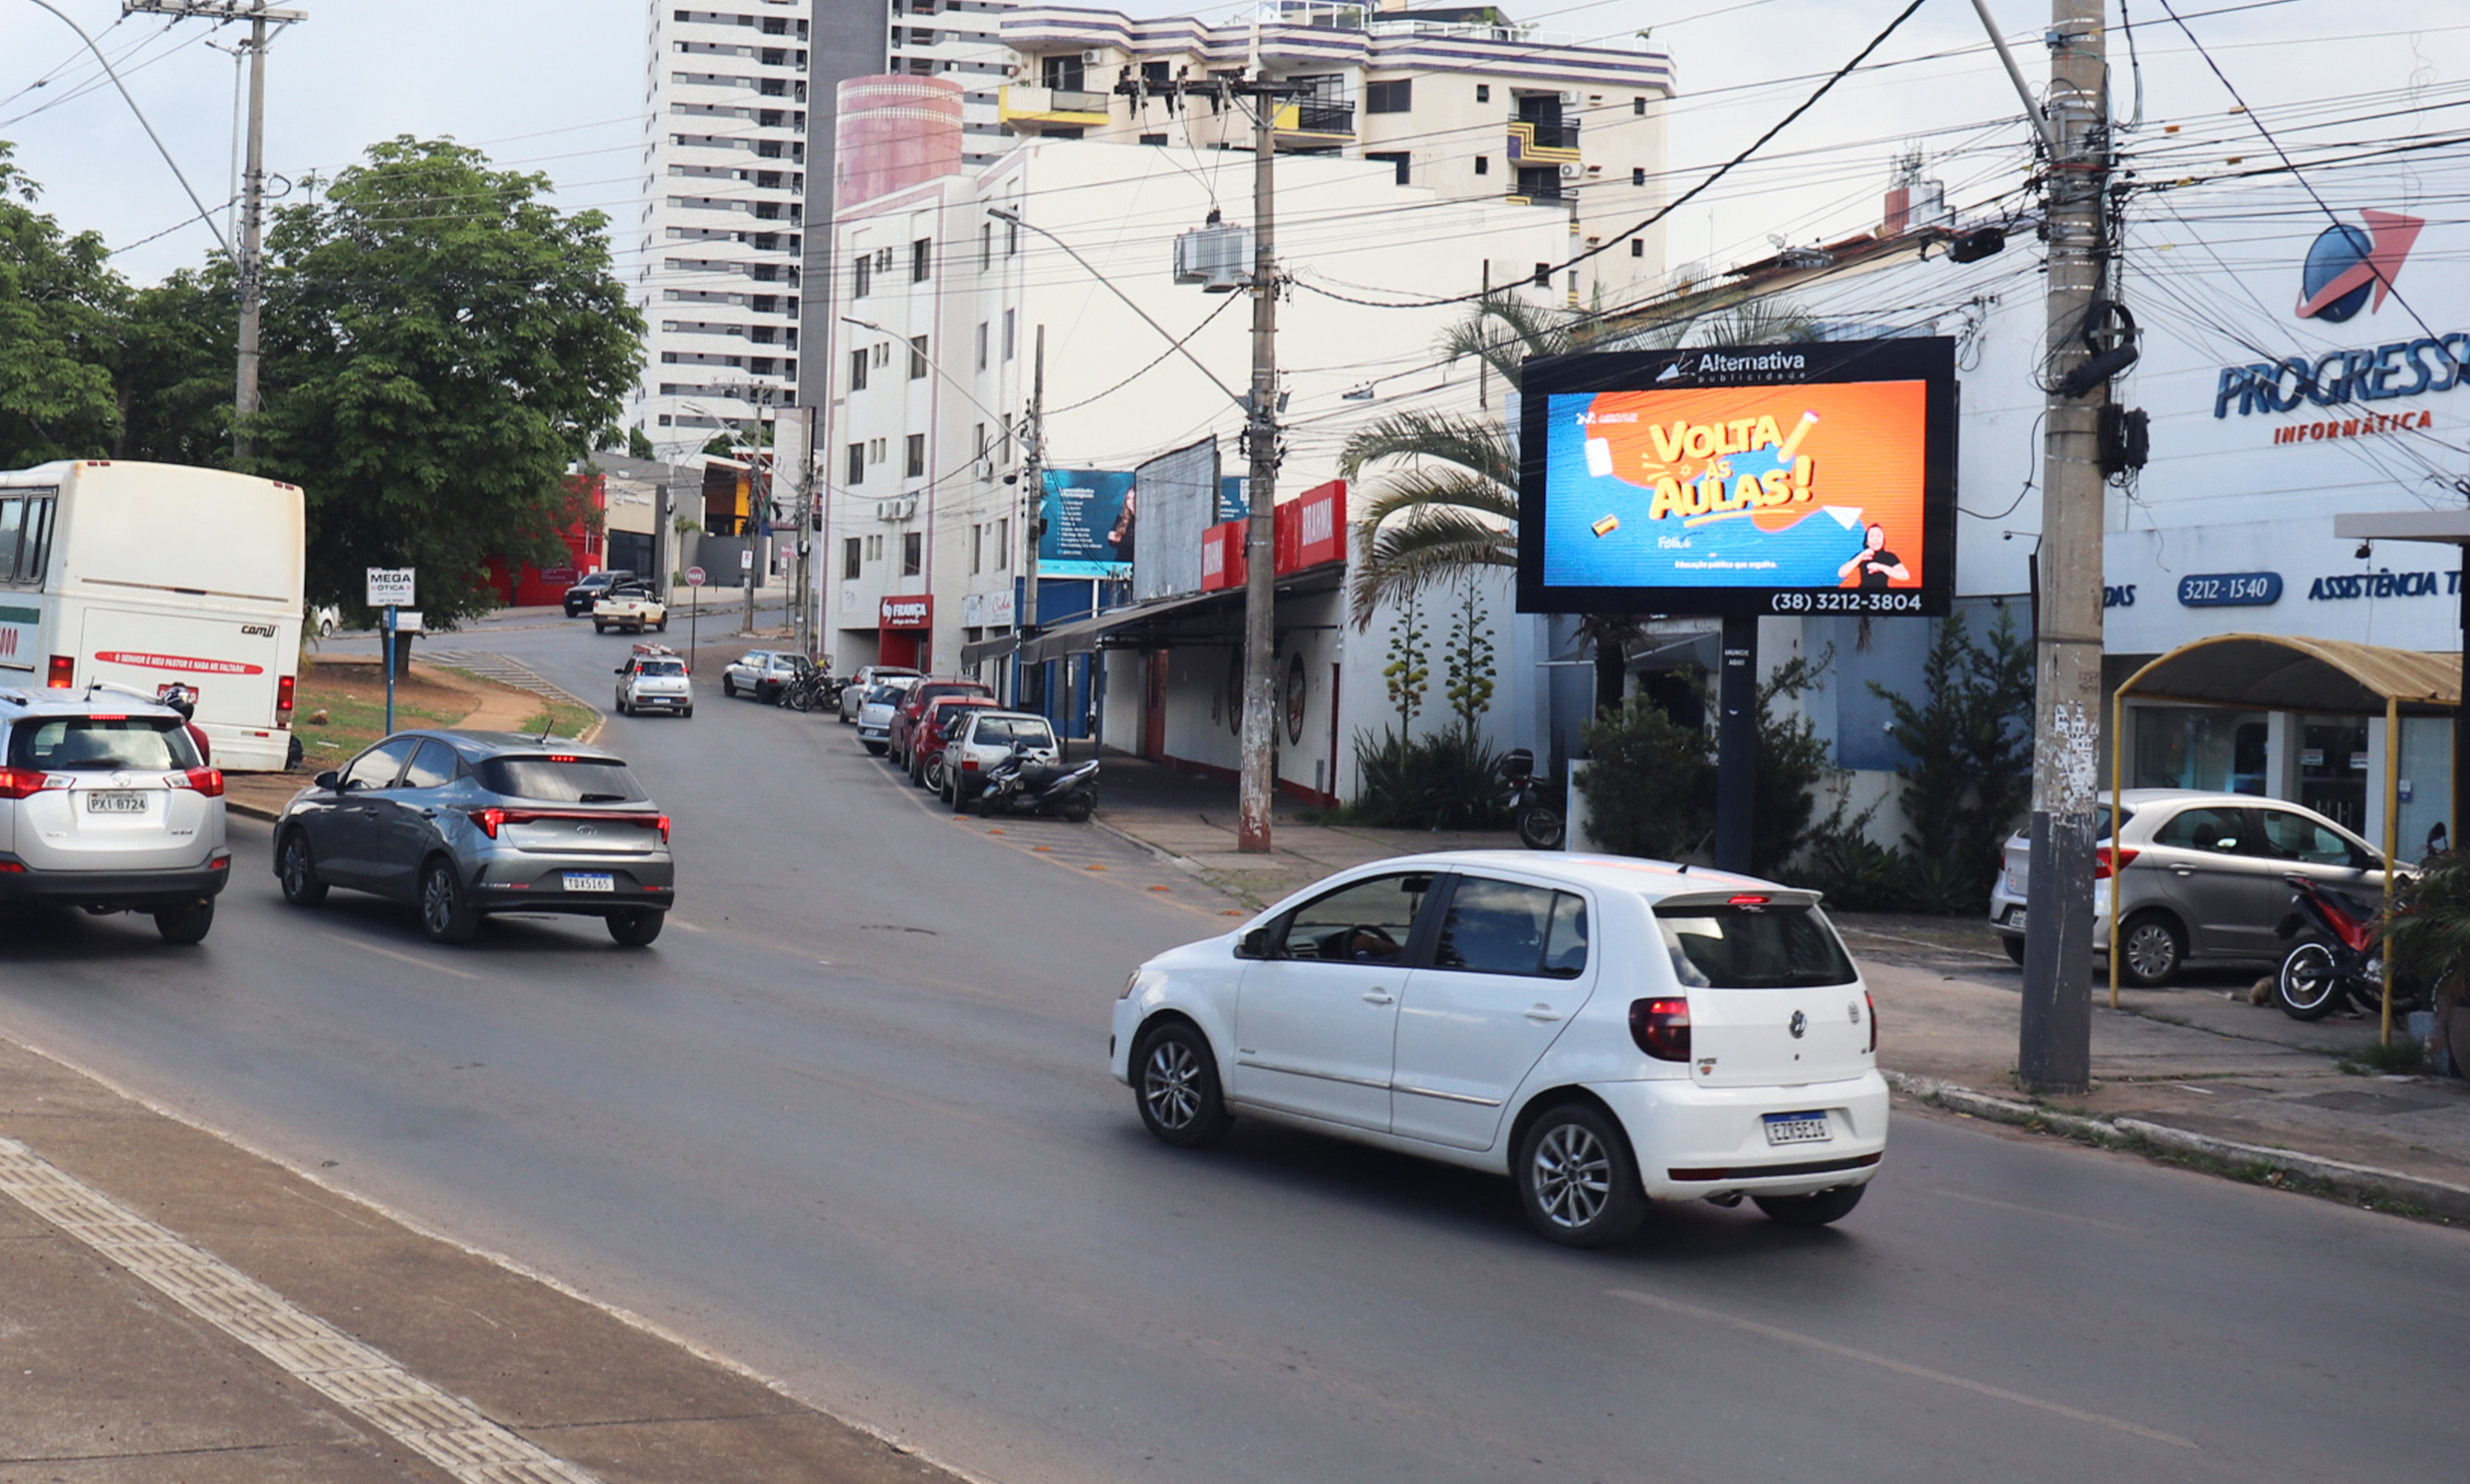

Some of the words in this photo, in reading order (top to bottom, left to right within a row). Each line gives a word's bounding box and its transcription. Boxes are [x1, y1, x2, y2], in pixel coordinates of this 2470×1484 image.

[1698, 351, 1806, 372] Alternativa
[1697, 371, 1807, 383] publicidade
[2273, 409, 2432, 445] INFORMÁTICA
[1648, 414, 1786, 463] VOLTA
[1705, 457, 1734, 480] ÀS
[1648, 454, 1815, 520] AULAS!
[370, 574, 411, 584] MEGA
[2307, 567, 2438, 601] ASSISTÊNCIA
[892, 603, 927, 618] FRANÇA
[1771, 593, 1813, 612] (38)
[1816, 594, 1922, 611] 3212-3804
[121, 653, 145, 664] SENHOR
[164, 657, 188, 668] PASTOR
